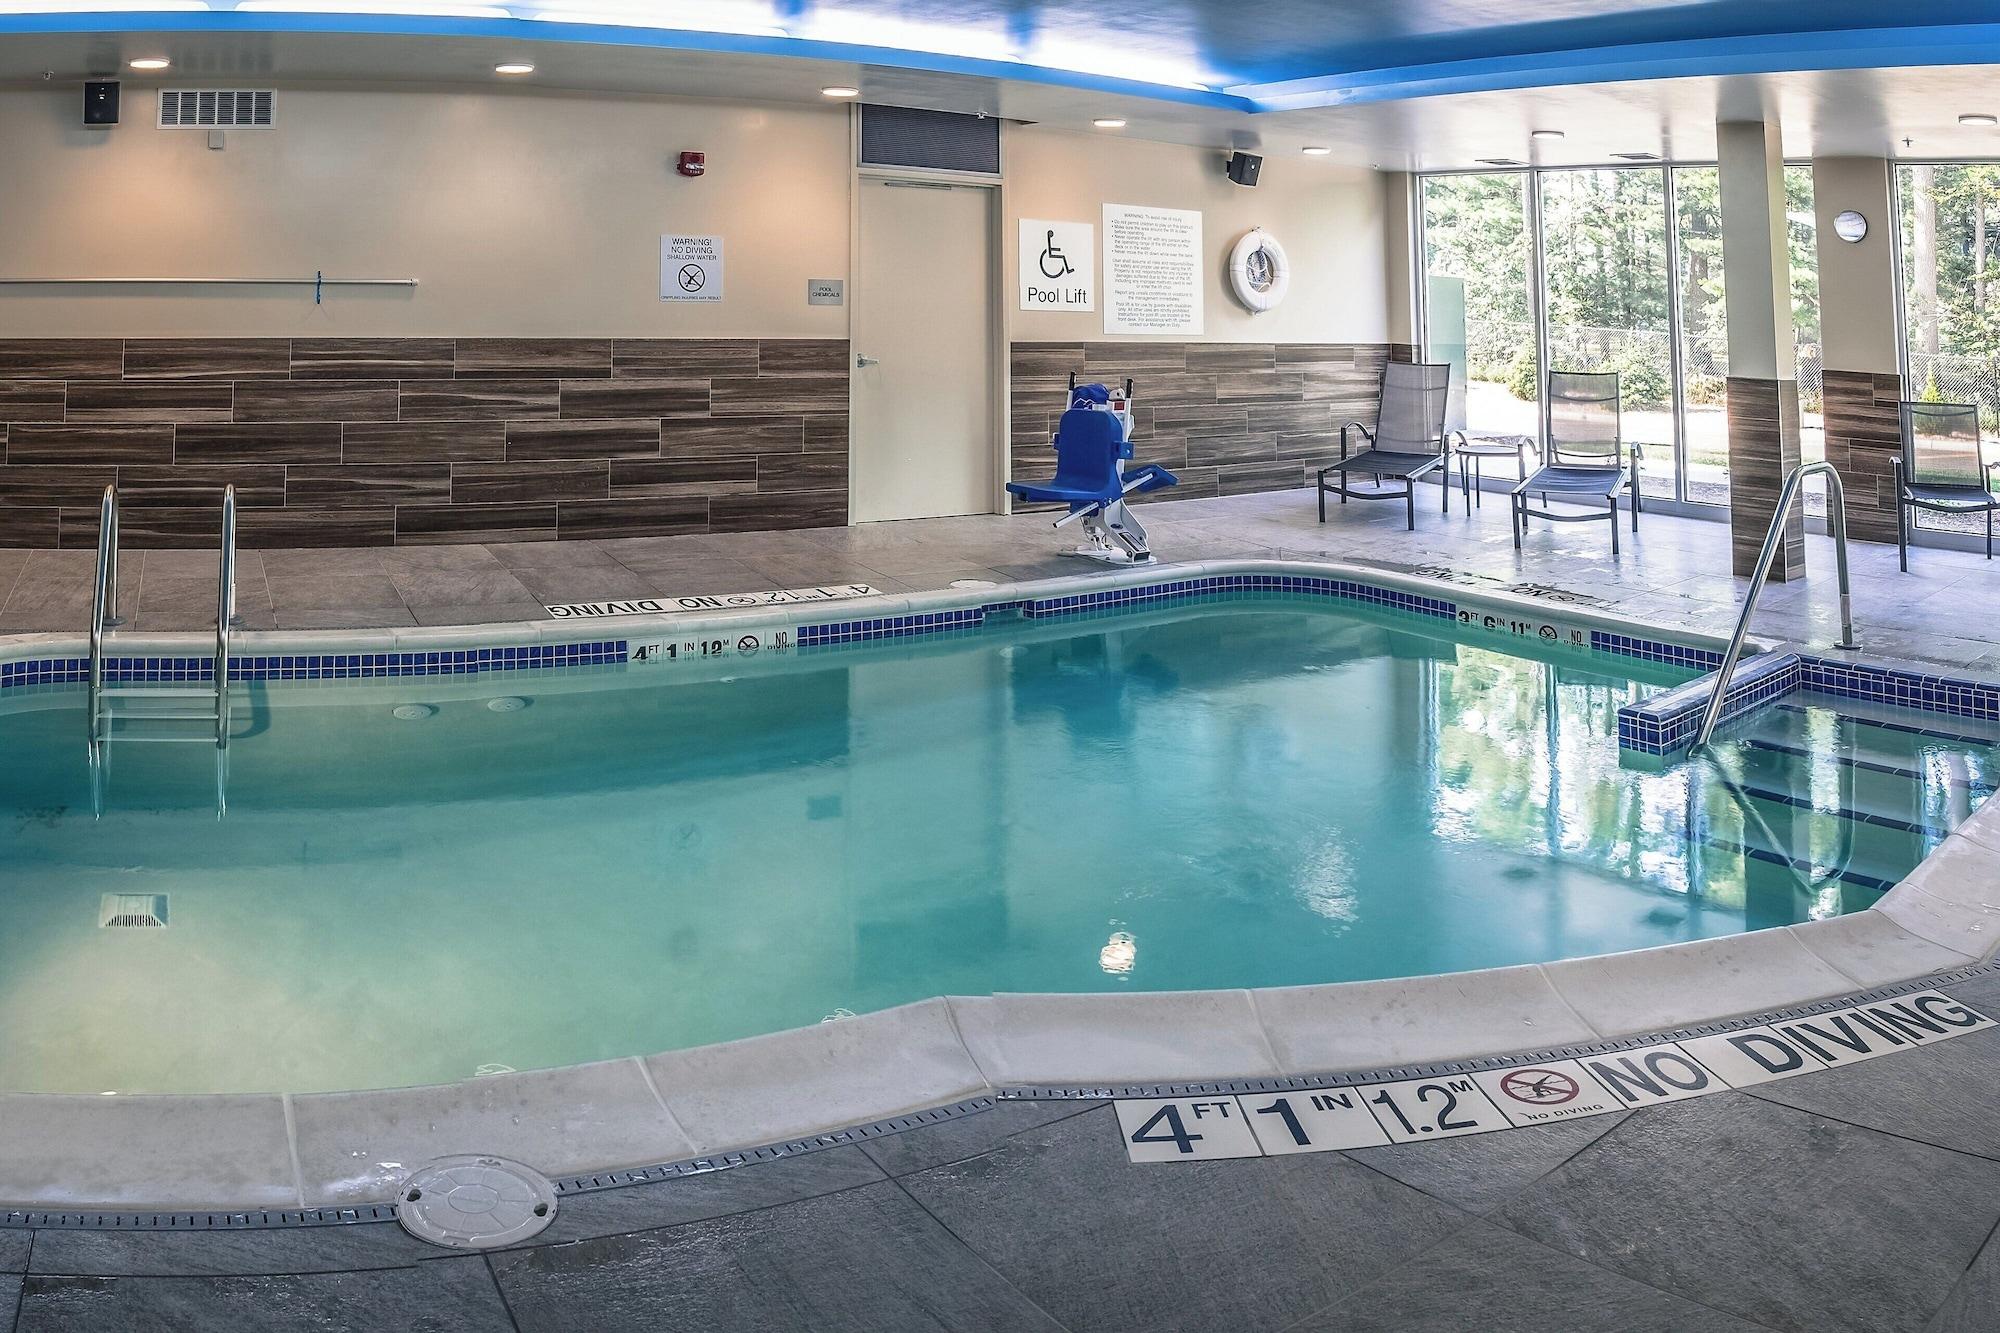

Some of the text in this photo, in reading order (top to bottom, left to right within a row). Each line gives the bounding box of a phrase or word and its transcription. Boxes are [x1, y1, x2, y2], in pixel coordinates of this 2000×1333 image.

[672, 238, 712, 246] WARNING!
[671, 246, 713, 254] NO DIVING
[1028, 287, 1087, 304] Pool Lift
[548, 600, 664, 617] DIVING
[678, 596, 723, 609] NO
[1471, 612, 1479, 621] FT
[1497, 617, 1505, 627] IN
[776, 631, 788, 645] NO
[1571, 629, 1582, 643] NO
[632, 646, 648, 660] 4
[648, 644, 660, 654] FT
[667, 643, 677, 658] 1
[684, 642, 695, 652] IN
[1587, 996, 1978, 1102] NO DIVING
[1371, 1084, 1479, 1135] 1.2
[1527, 1104, 1604, 1120] NO DIVING
